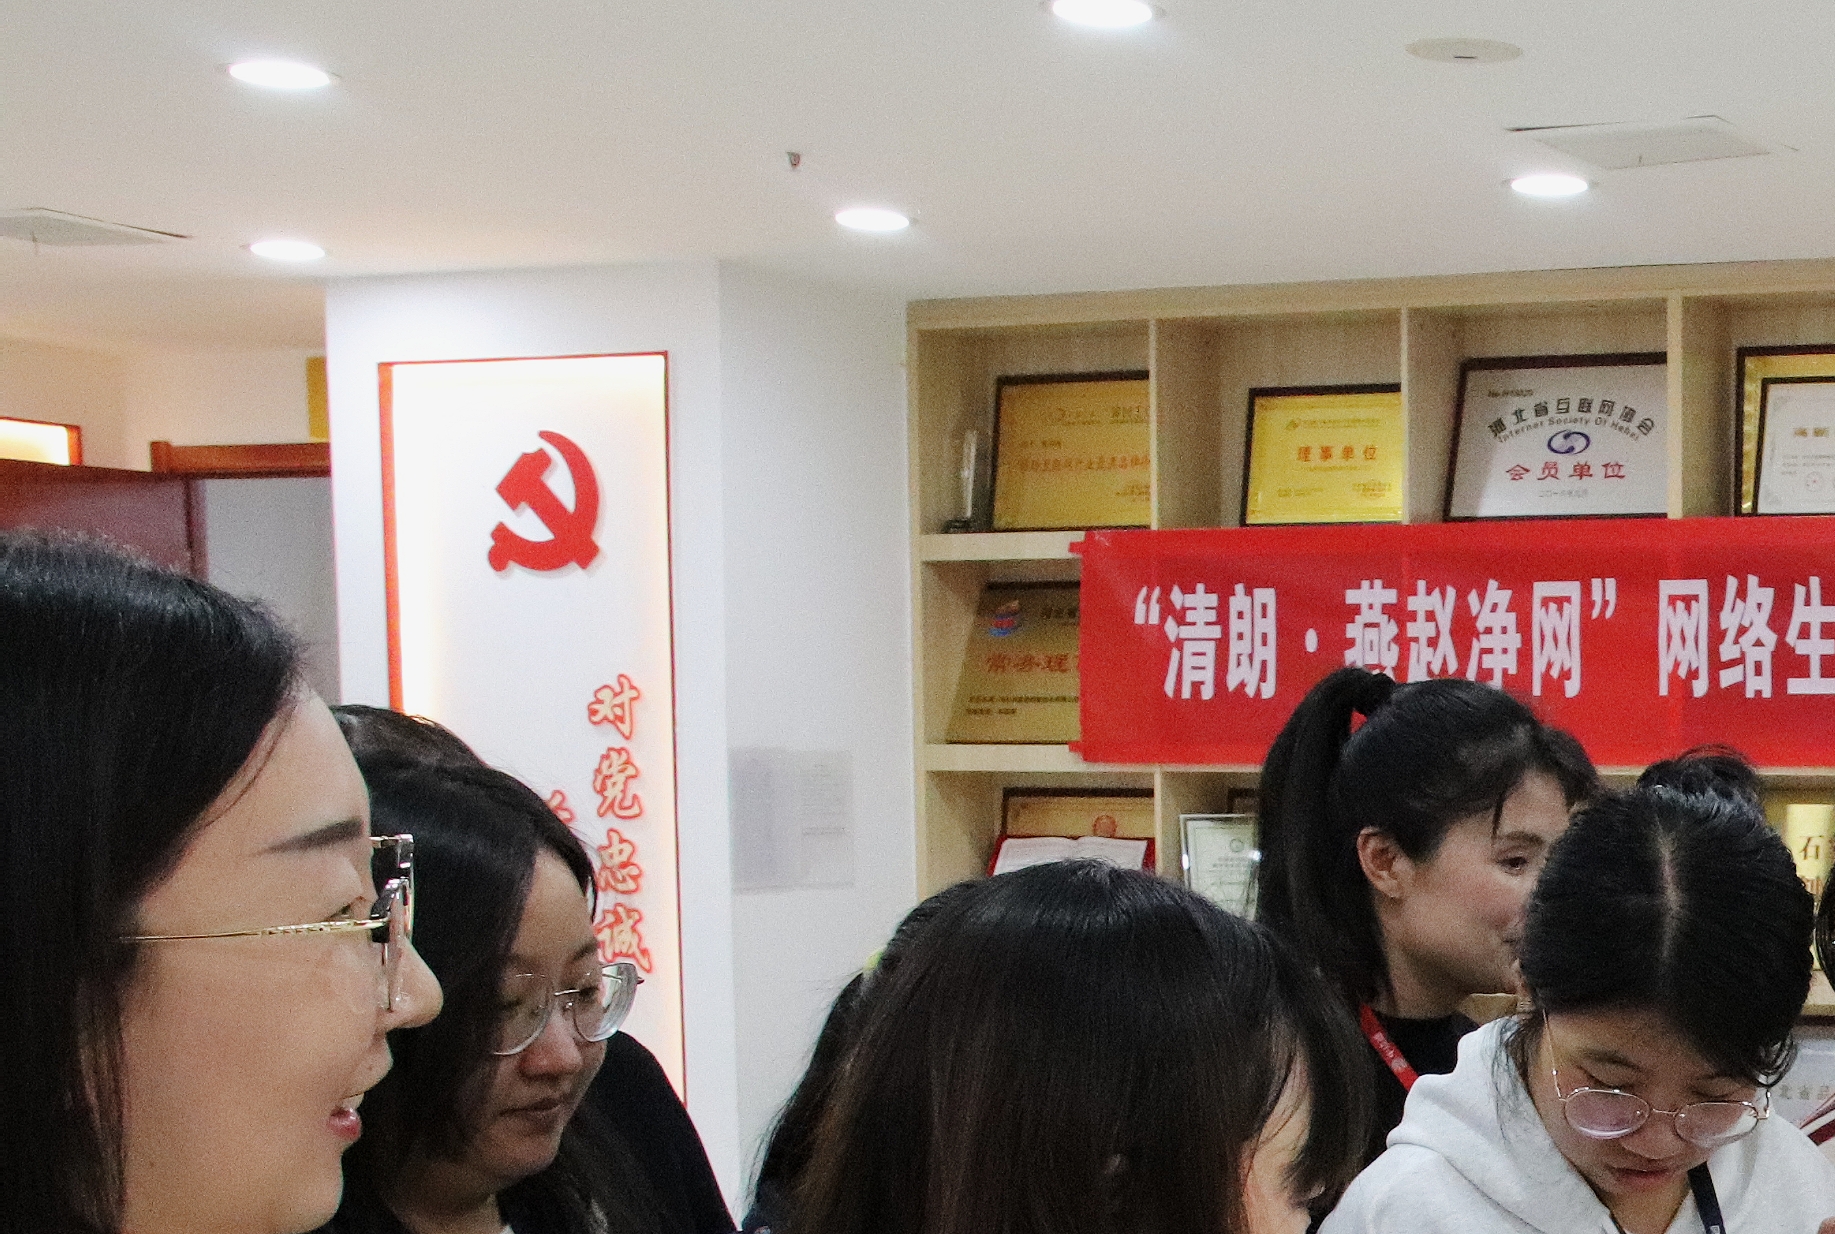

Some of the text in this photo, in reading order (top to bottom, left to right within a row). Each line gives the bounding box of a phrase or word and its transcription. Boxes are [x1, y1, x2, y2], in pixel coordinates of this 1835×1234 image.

[1297, 445, 1378, 463] 理事单位
[1506, 460, 1626, 481] 会员单位
[986, 653, 1080, 674] 常务理
[587, 673, 653, 974] 对党忠诚
